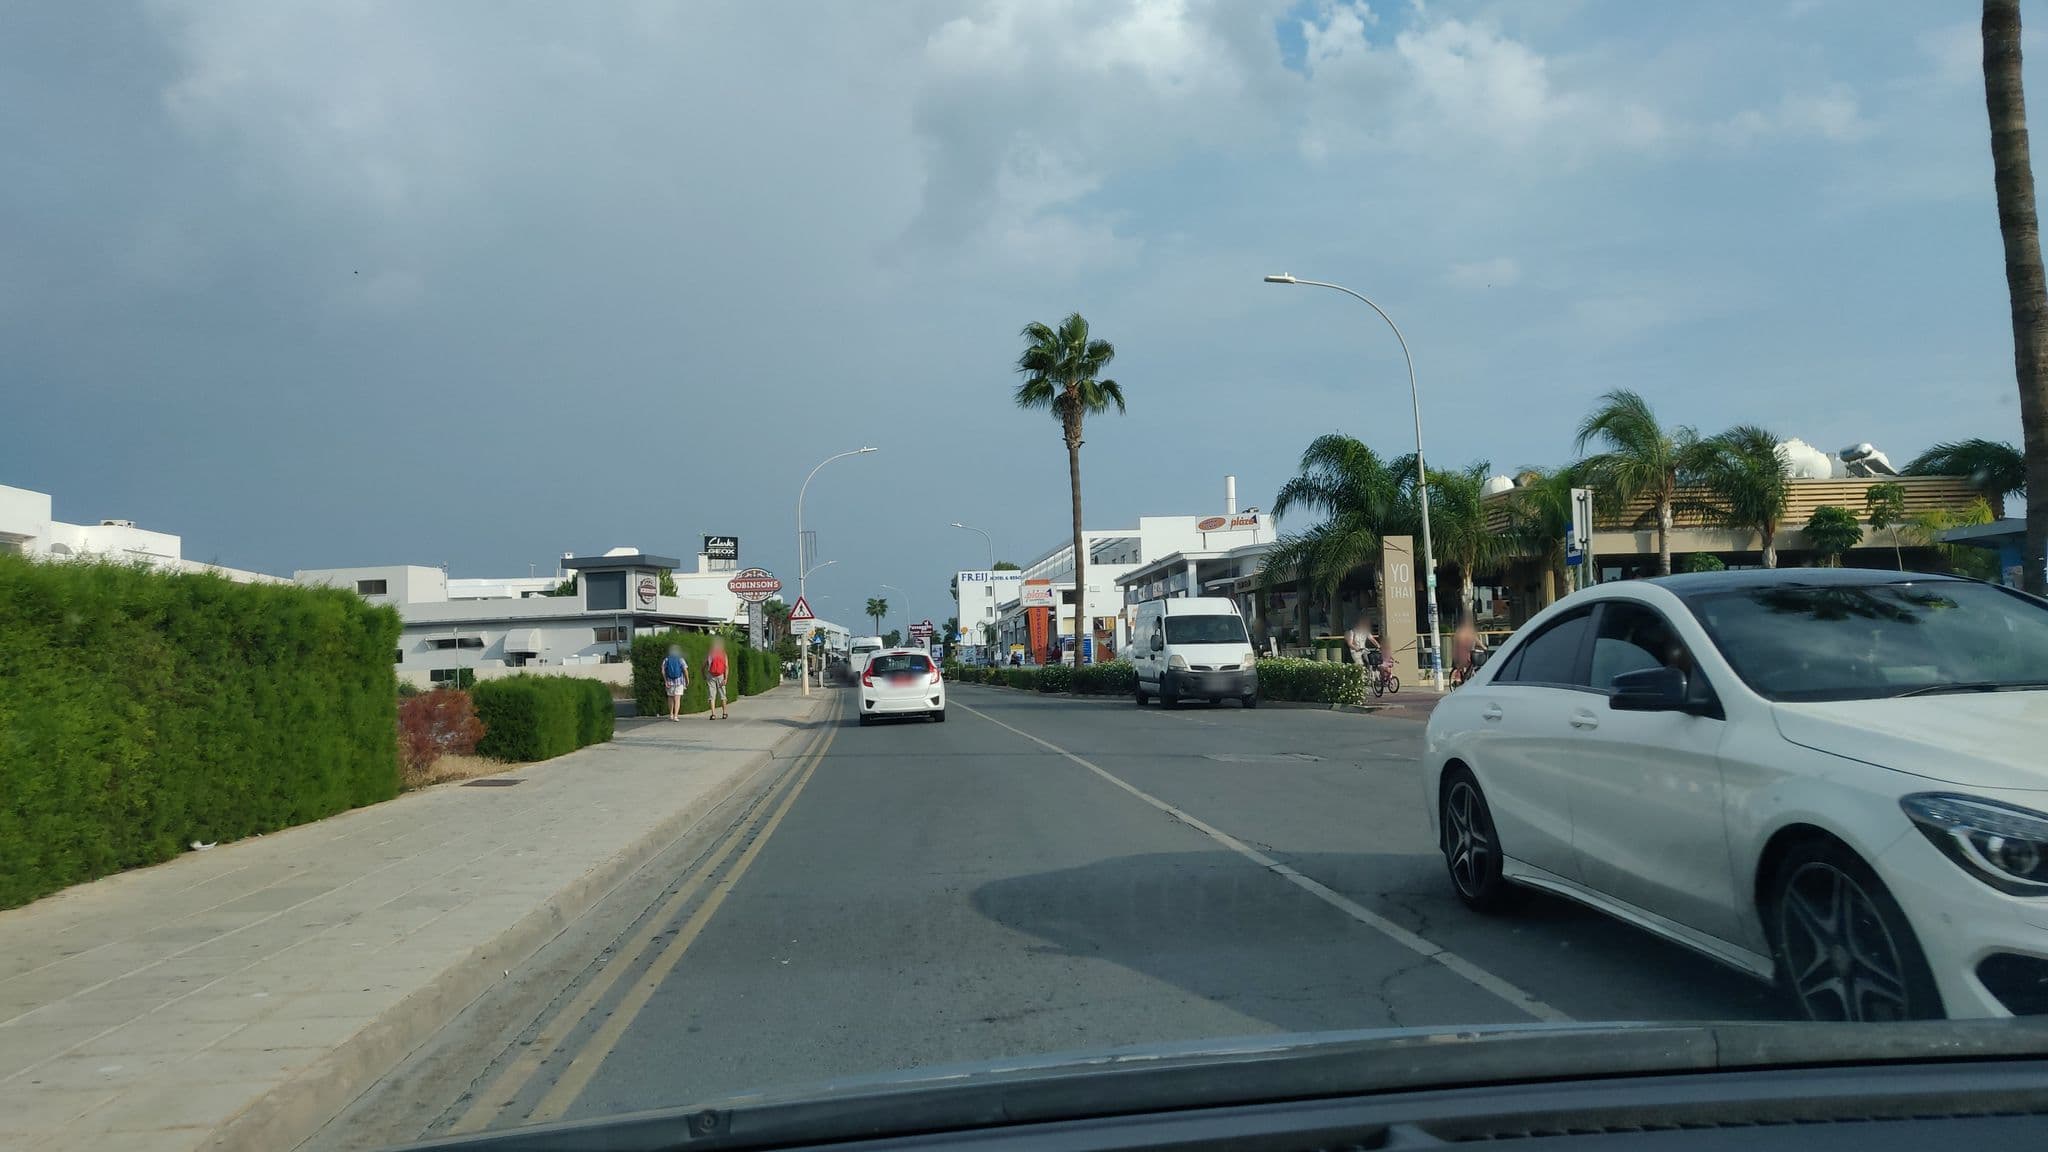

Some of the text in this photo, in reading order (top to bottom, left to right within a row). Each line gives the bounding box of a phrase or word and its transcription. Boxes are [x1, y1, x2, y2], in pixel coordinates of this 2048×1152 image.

[708, 536, 735, 547] Clarks
[961, 572, 988, 582] FREIJ
[1390, 563, 1409, 583] YO
[729, 580, 779, 590] ROBINSONS
[1391, 586, 1413, 599] THAI
